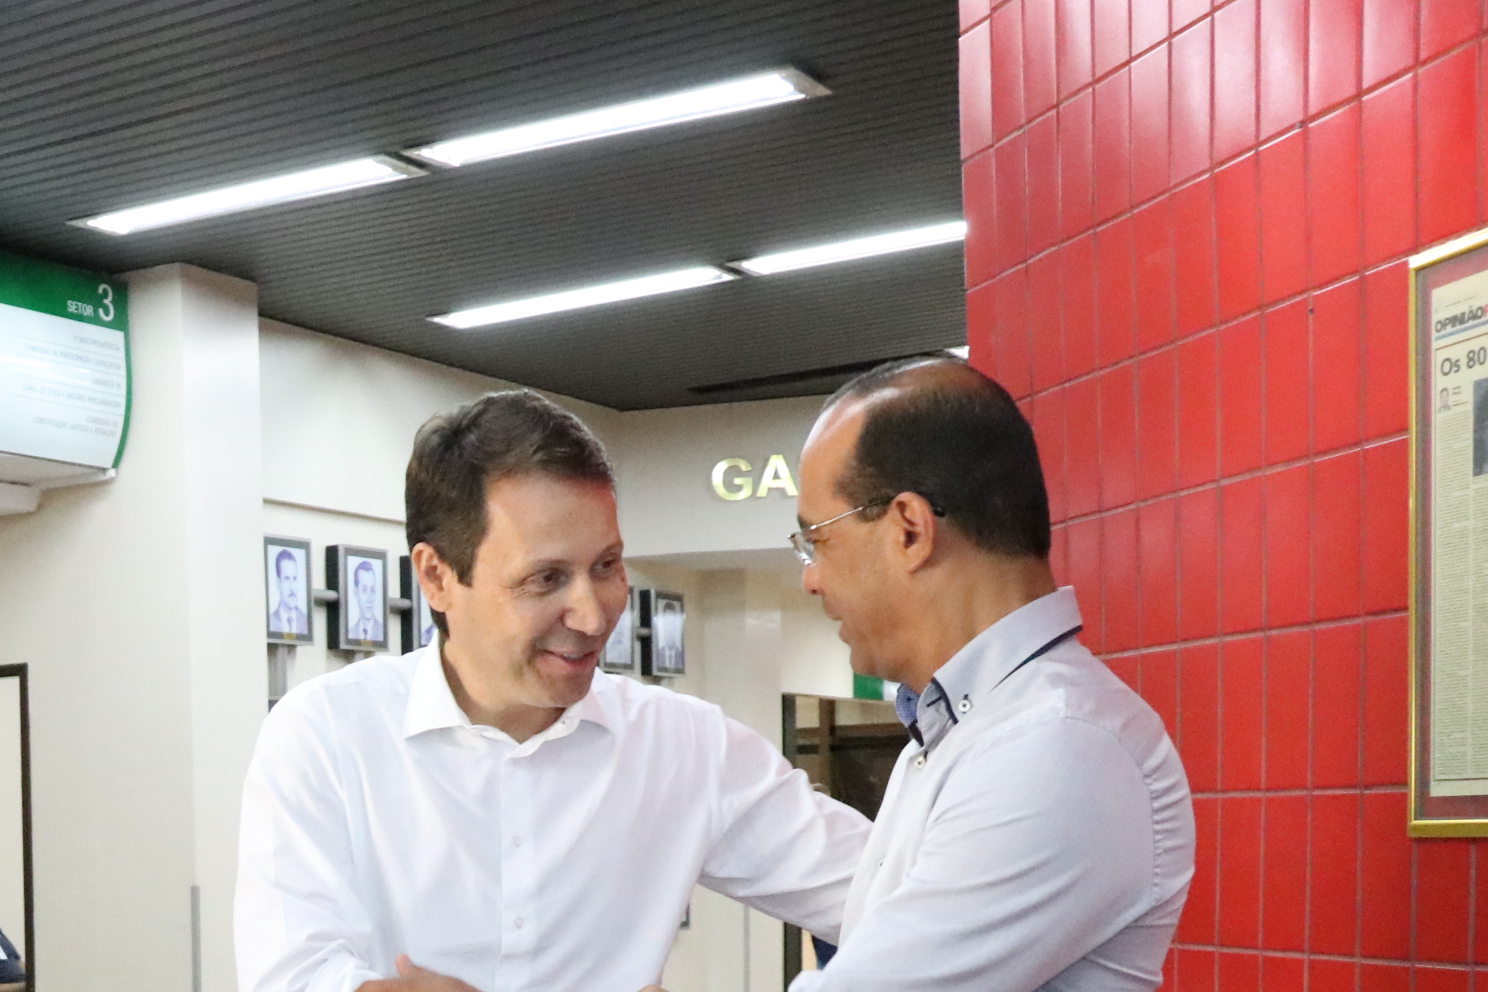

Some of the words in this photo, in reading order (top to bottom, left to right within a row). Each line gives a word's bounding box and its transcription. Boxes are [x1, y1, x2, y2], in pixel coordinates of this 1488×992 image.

[67, 299, 94, 317] SETOR
[98, 283, 115, 322] 3
[1435, 305, 1484, 333] OPINIÃO
[1440, 357, 1461, 377] Os
[1466, 346, 1487, 369] 80
[711, 454, 800, 501] GA
